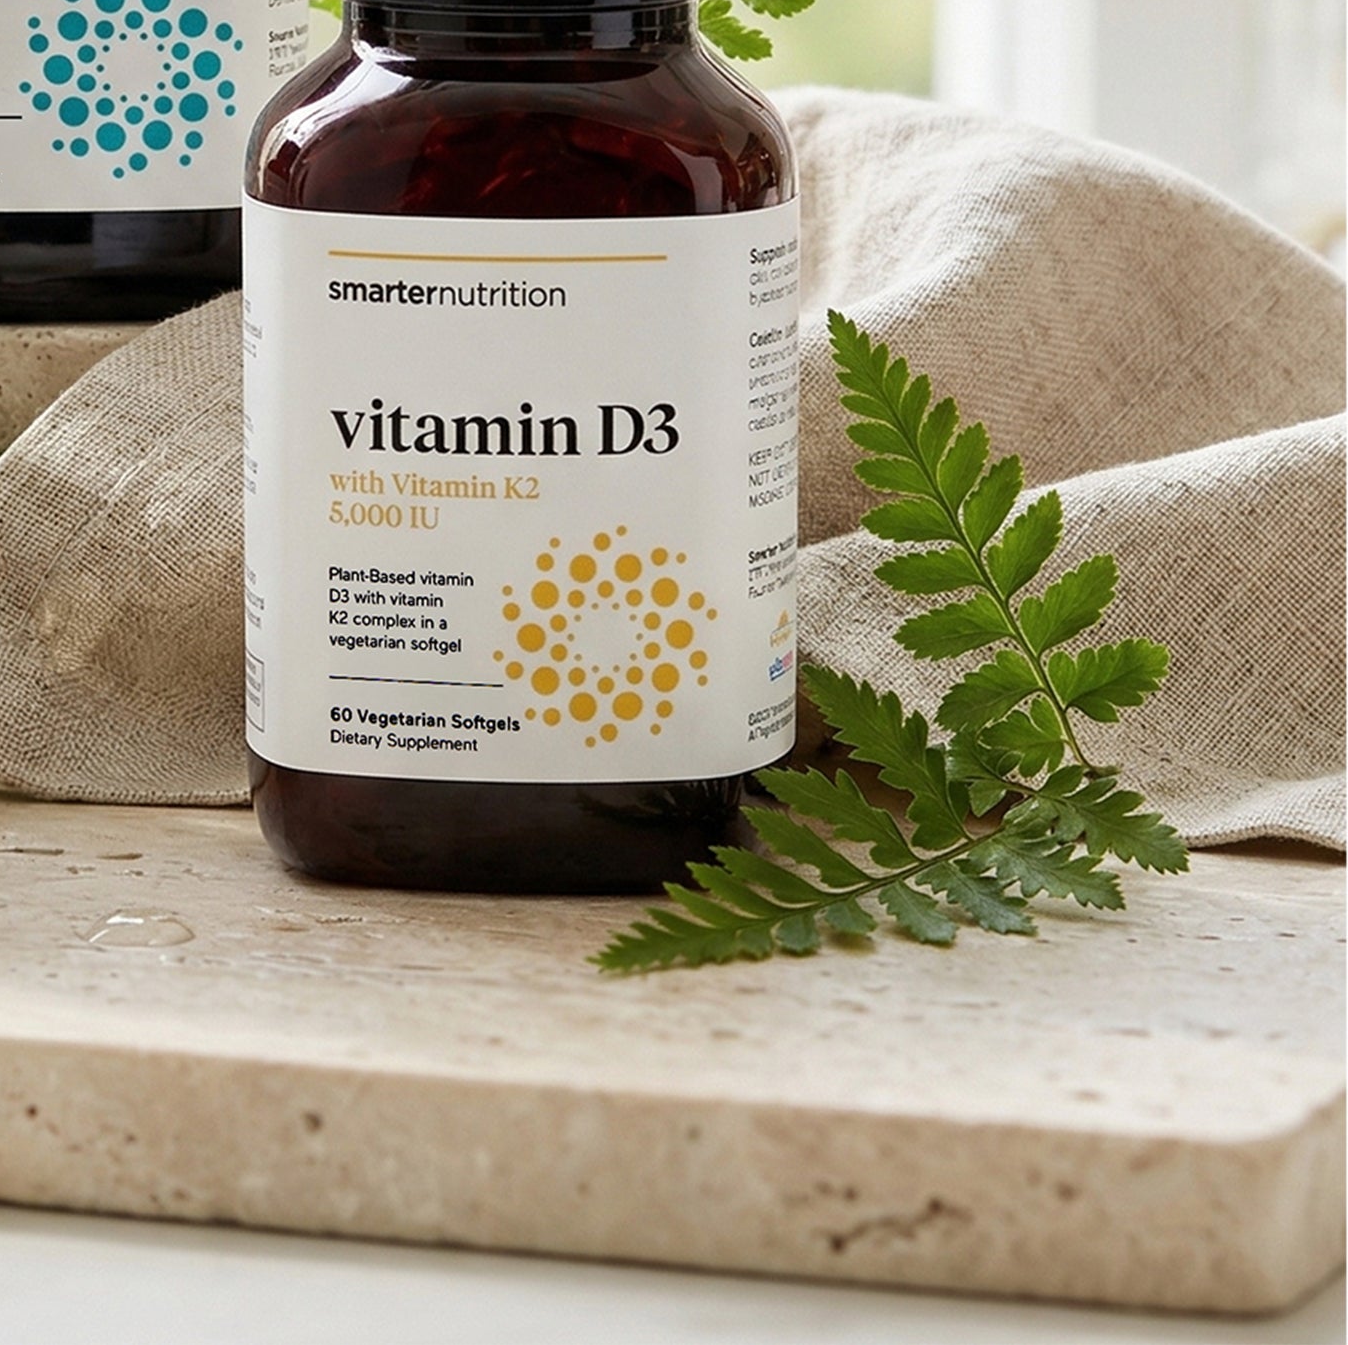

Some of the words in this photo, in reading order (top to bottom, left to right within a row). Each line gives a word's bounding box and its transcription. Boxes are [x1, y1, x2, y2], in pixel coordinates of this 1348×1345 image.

[329, 280, 566, 307] smarternutrition
[330, 398, 581, 456] vitamin
[597, 403, 679, 455] D3
[329, 470, 384, 496] with
[392, 473, 496, 499] Vitamin
[504, 476, 540, 500] K2
[329, 501, 403, 529] 5,000
[410, 505, 440, 530] IU
[329, 567, 415, 584] Plant-Based
[420, 571, 474, 587] vitamin
[329, 589, 350, 604] D3
[354, 590, 386, 606] with
[390, 592, 444, 608] vitamin
[329, 610, 348, 626] K2
[353, 613, 416, 631] complex
[421, 615, 435, 630] in
[439, 619, 448, 631] a
[329, 635, 405, 650] vegetarian
[411, 637, 461, 655] softgel
[330, 707, 352, 723] 60
[357, 709, 447, 729] Vegetarian
[451, 713, 521, 734] Softgels
[330, 731, 382, 749] Dietary
[387, 733, 479, 753] Supplement
